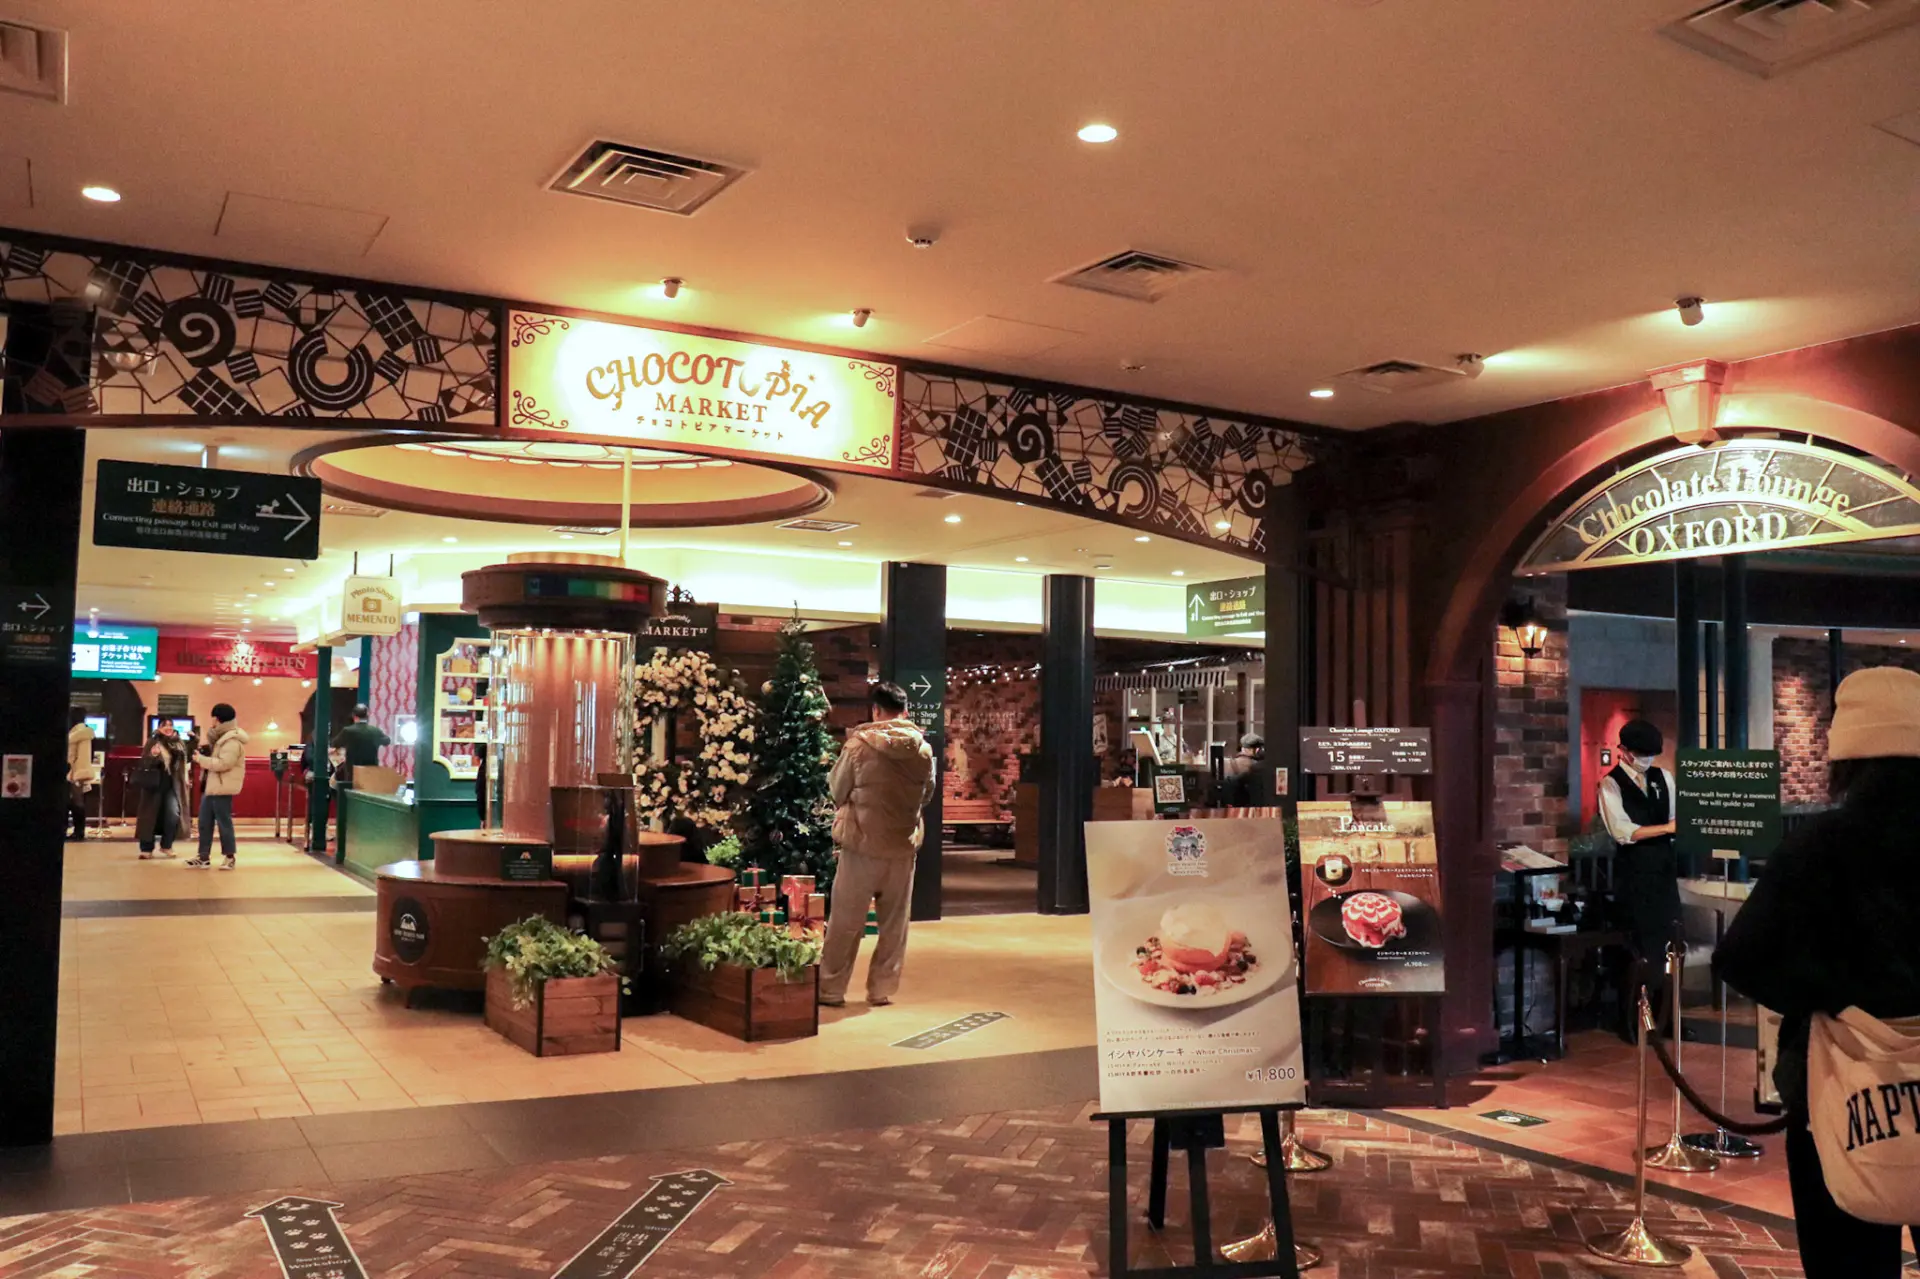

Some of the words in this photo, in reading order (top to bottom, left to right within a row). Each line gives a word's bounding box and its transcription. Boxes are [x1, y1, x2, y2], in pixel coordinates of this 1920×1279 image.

[655, 392, 767, 423] MARKET
[636, 415, 784, 440] チョコトピアマーケット
[127, 477, 241, 500] 出口・ショップ
[151, 498, 216, 517] 連絡通路
[1578, 472, 1719, 546] Chocolate
[1730, 465, 1852, 518] Lounge
[103, 512, 152, 525] Connecting
[154, 517, 189, 528] passage
[191, 519, 201, 527] to
[202, 520, 219, 529] Exit
[221, 522, 237, 530] and
[239, 523, 260, 533] Shop
[1628, 512, 1788, 556] OXFORD
[1209, 586, 1257, 601] 出口・ショップ
[347, 613, 397, 625] MEMENTO
[921, 711, 938, 719] Shop
[1328, 751, 1345, 763] 15
[1680, 760, 1775, 769] スタッフがご案内いたしますので
[1686, 770, 1768, 779] こちらで少々お待ちください
[1679, 790, 1700, 798] Please
[1338, 815, 1395, 832] Pancake
[1247, 1067, 1296, 1083] ¥1,800
[289, 1259, 352, 1269] Workshop
